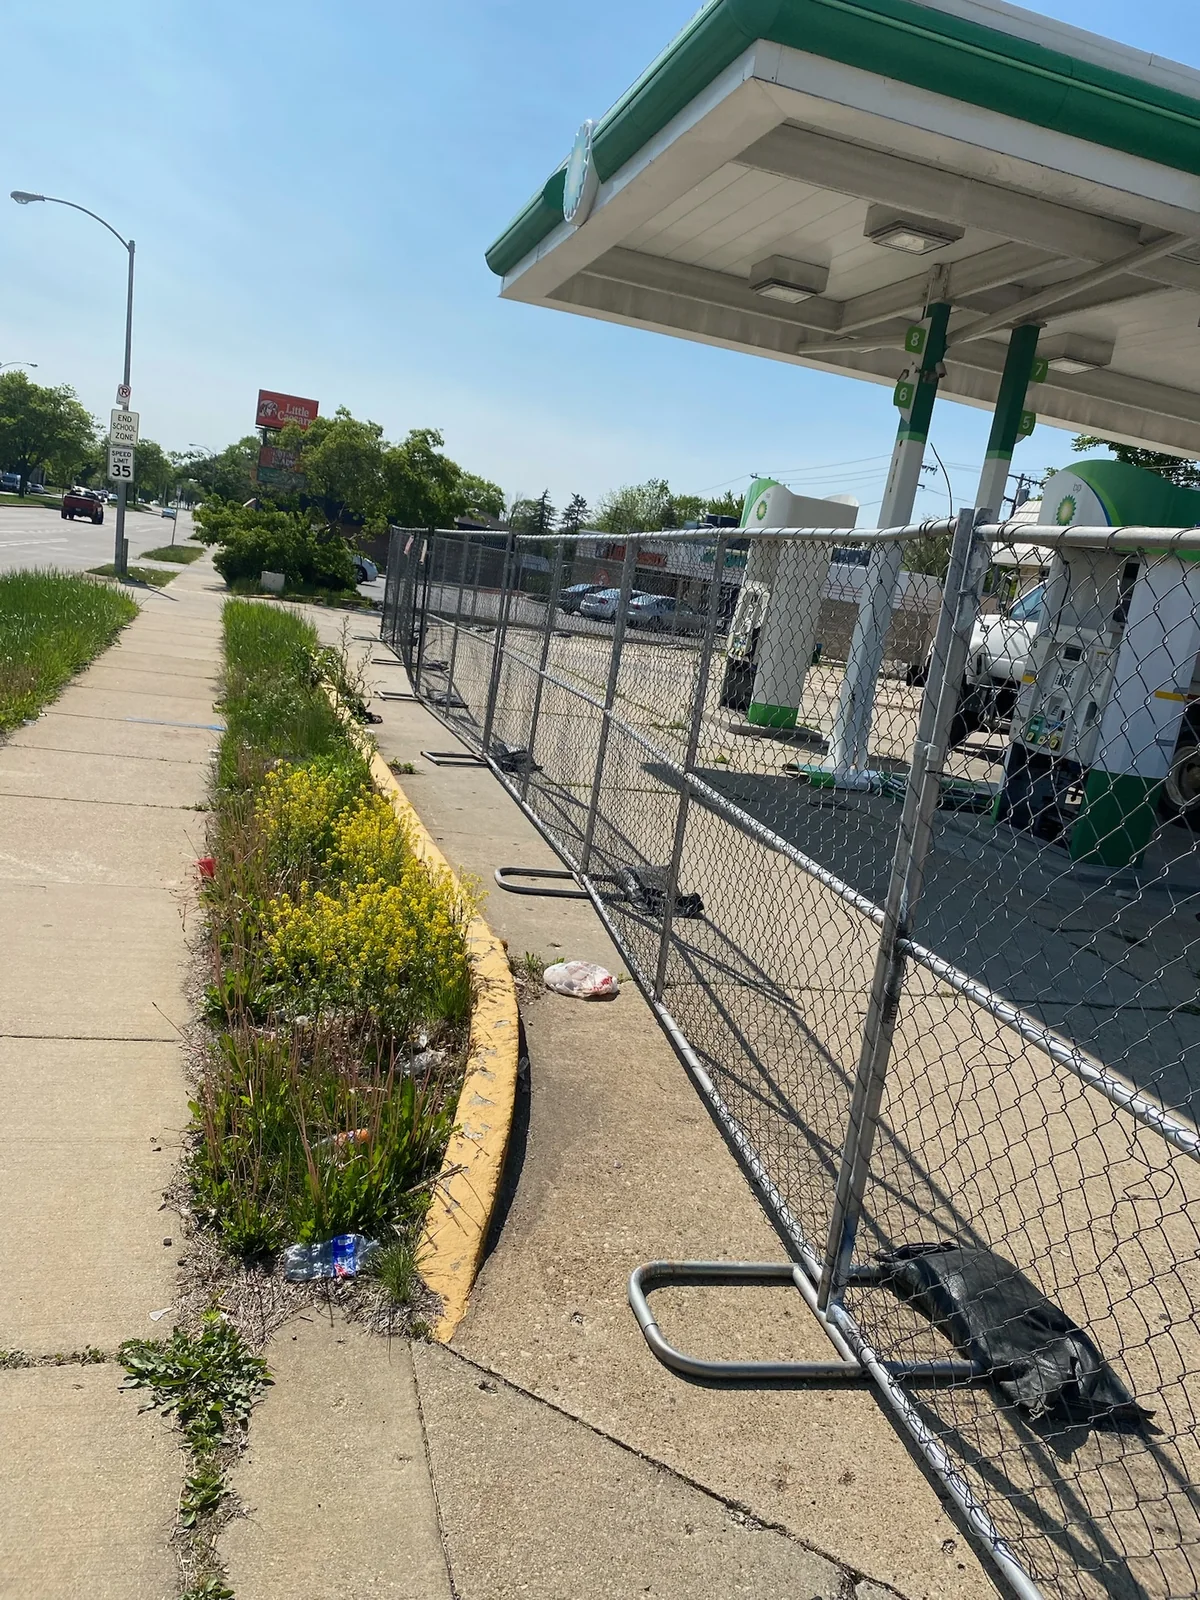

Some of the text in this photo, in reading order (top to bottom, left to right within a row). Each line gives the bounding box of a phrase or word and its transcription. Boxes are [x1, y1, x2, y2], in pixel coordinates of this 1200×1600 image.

[911, 332, 920, 347] 8
[1035, 362, 1044, 376] 7
[899, 387, 908, 401] 6
[286, 403, 309, 418] Little
[117, 414, 132, 423] END
[1022, 416, 1031, 430] 5
[112, 422, 136, 433] SCHOOL
[115, 432, 133, 442] ZONE
[112, 450, 131, 458] SPEED
[112, 464, 131, 478] 35
